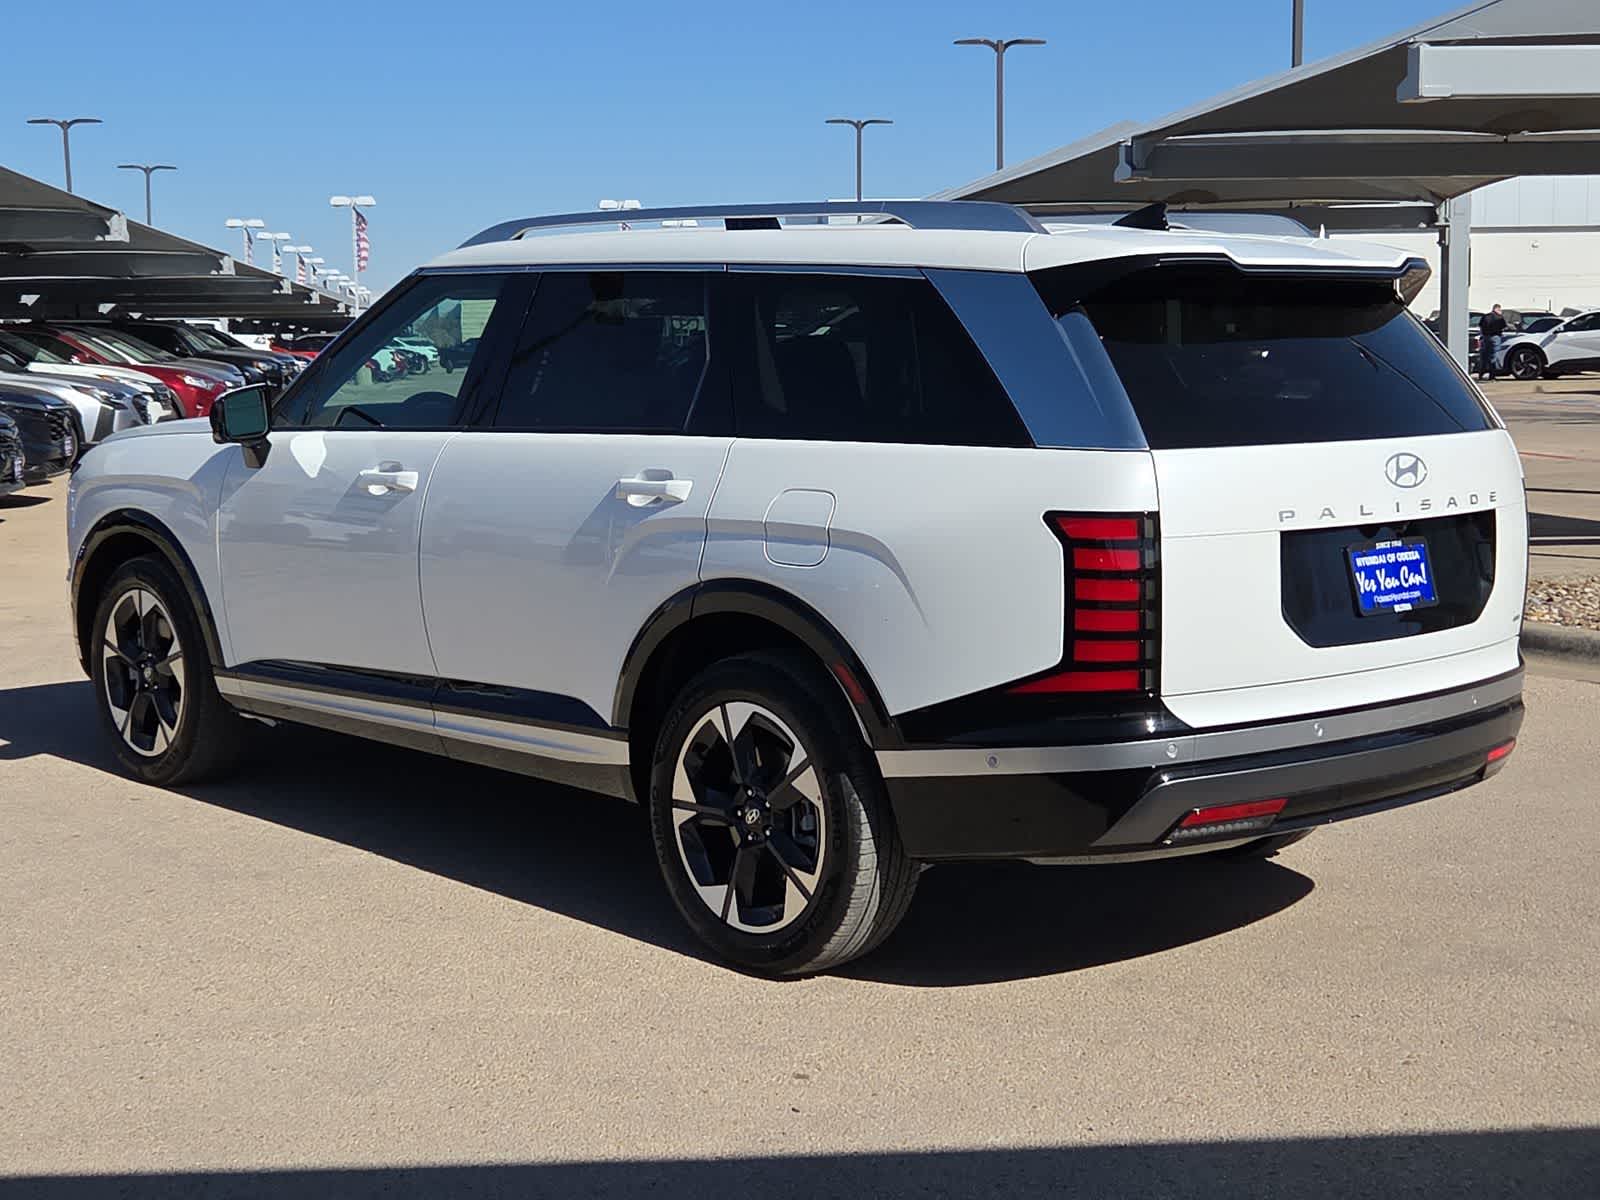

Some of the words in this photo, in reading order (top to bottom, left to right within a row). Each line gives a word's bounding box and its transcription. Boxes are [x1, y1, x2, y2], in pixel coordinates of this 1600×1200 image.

[1278, 491, 1498, 523] PALISADE
[1387, 553, 1396, 563] OF
[1355, 571, 1377, 594] Yes
[1376, 568, 1400, 591] You
[1400, 562, 1428, 588] Can!
